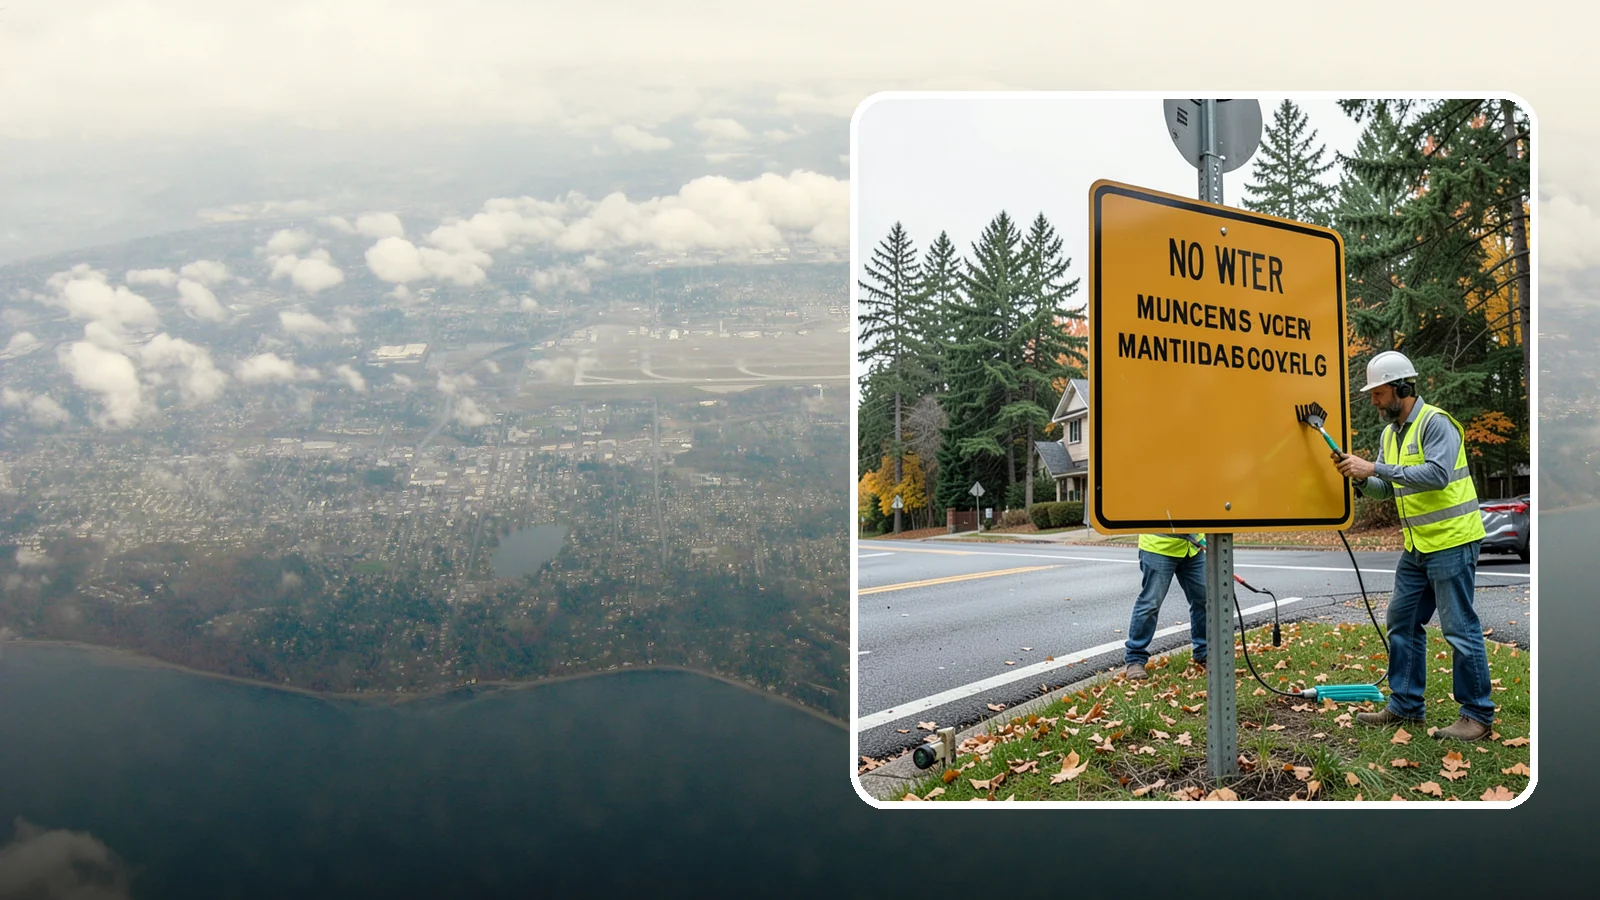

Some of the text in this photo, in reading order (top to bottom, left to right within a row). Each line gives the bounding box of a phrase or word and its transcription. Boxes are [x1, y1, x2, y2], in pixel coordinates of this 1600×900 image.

[1169, 237, 1284, 294] NO WTER
[1137, 293, 1252, 333] MUNCENS
